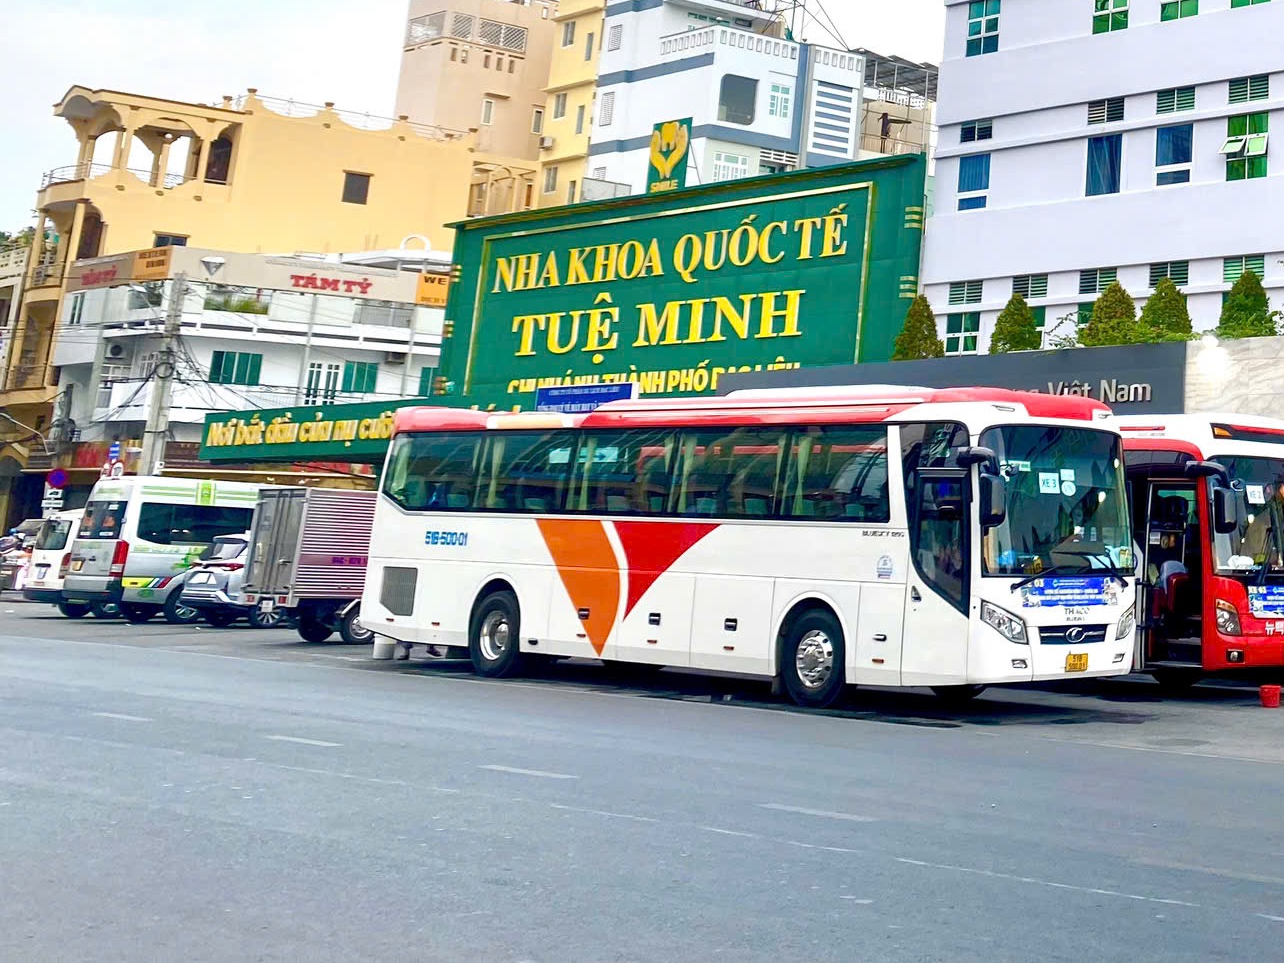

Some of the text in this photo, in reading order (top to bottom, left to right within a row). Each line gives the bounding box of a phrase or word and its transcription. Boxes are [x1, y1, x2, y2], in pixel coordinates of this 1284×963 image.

[492, 202, 849, 295] NHA KHOA QUỐC TẾ
[290, 273, 373, 294] TÁM TỶ
[511, 289, 806, 365] TUỆ MINH
[666, 359, 711, 393] PHỐ
[1100, 379, 1152, 403] Nam
[1042, 478, 1051, 488] XE
